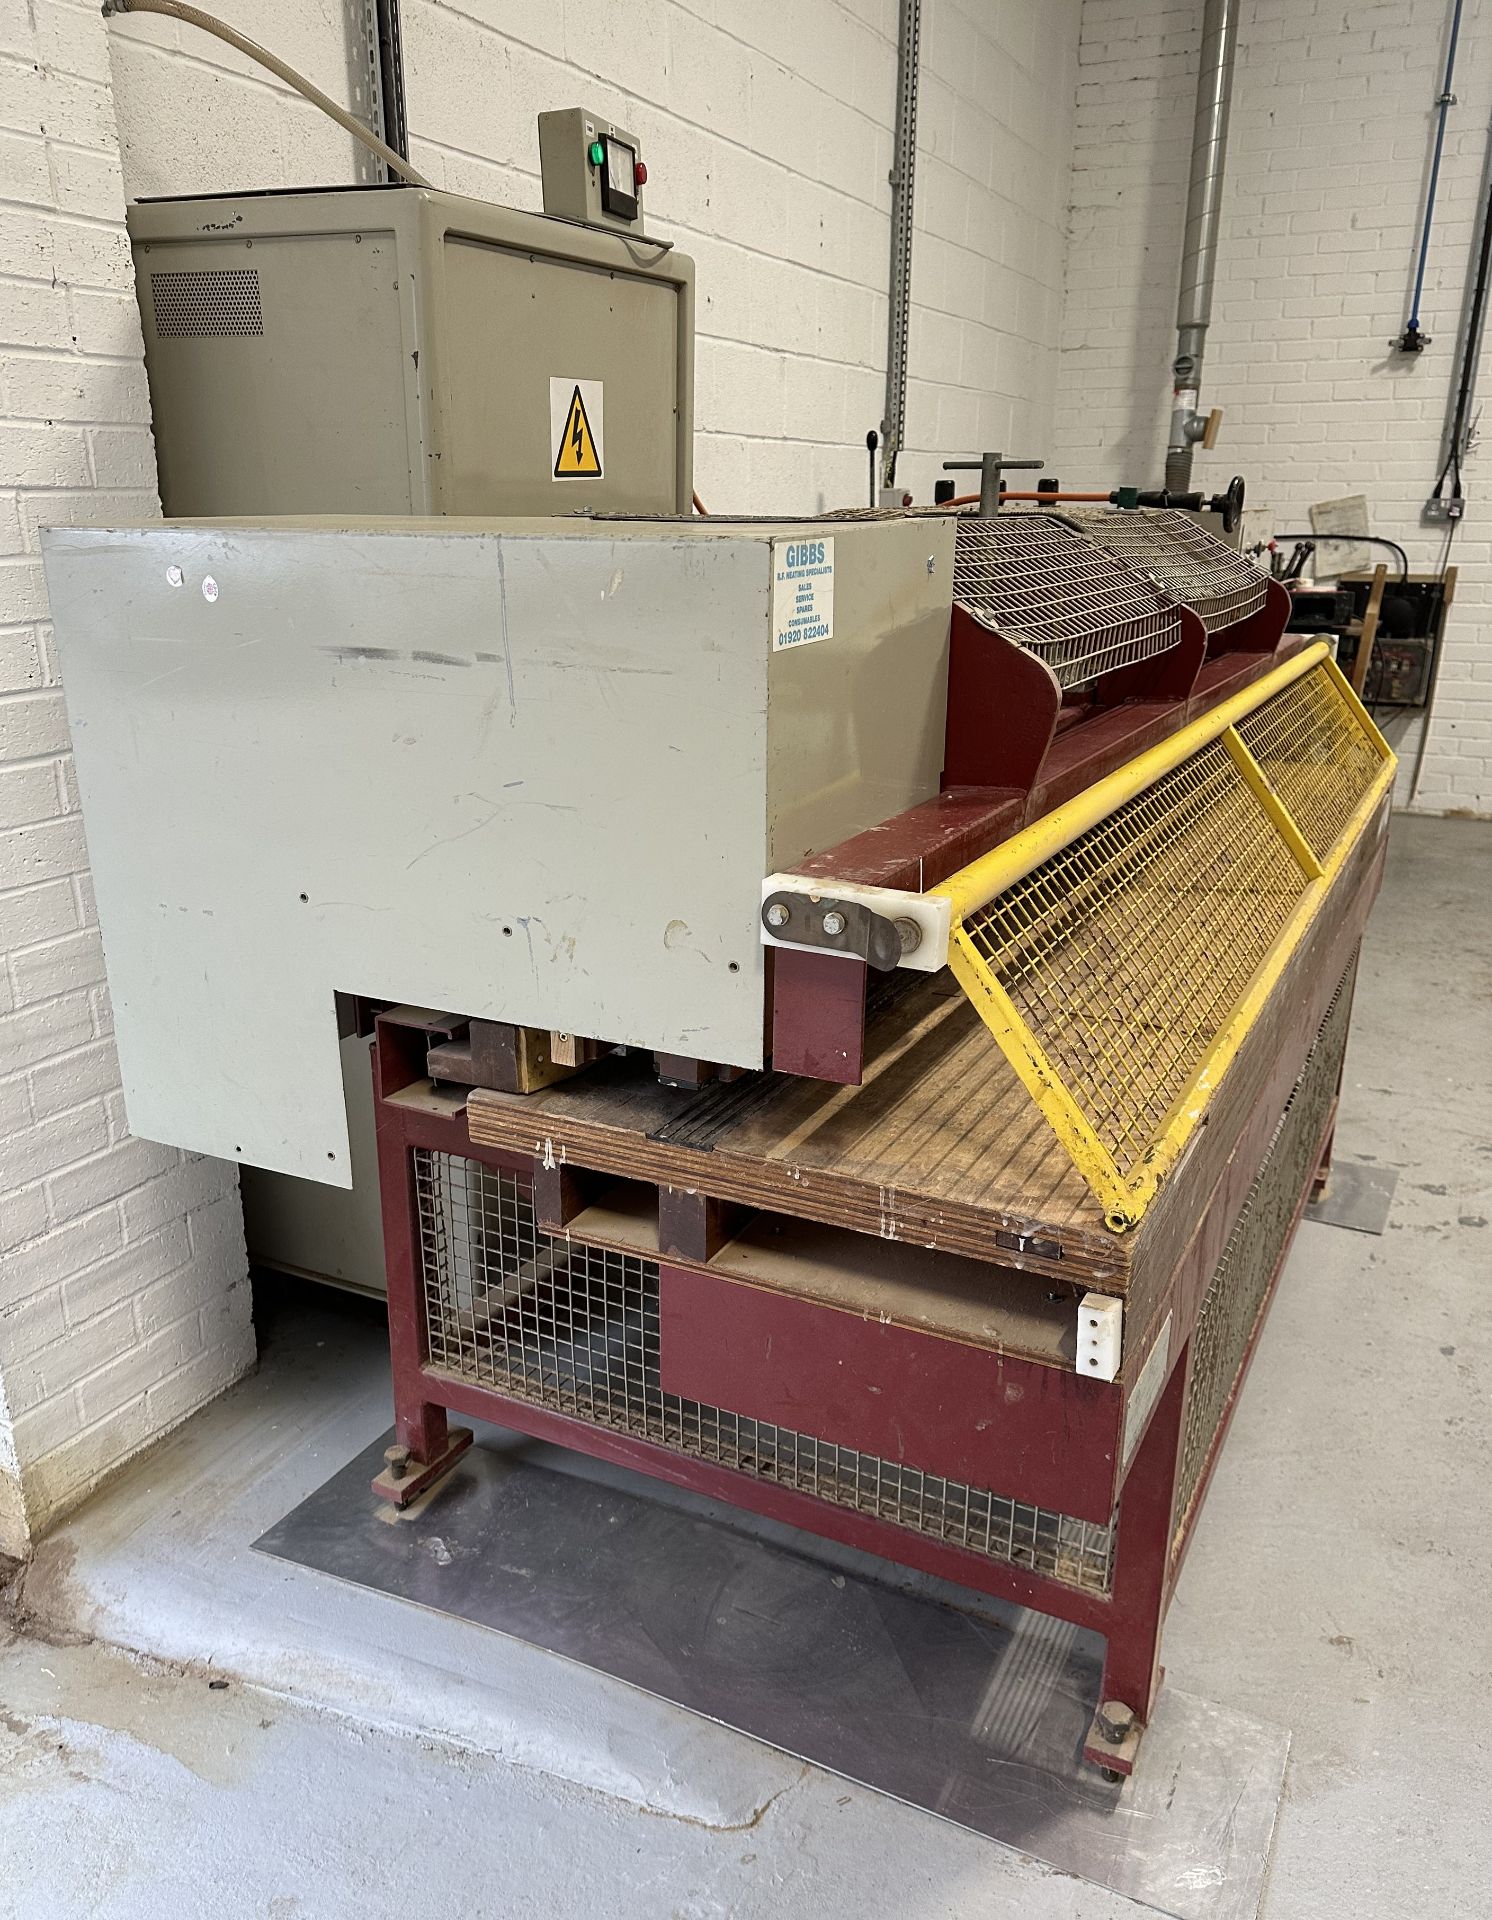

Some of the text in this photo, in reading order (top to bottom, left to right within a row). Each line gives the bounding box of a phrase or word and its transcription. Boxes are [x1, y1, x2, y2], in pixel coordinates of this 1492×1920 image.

[786, 542, 825, 568] GIBBS
[786, 570, 805, 580] HEATING
[806, 566, 832, 577] SPECIALISTS
[798, 583, 812, 592] SALES
[796, 593, 814, 603] SERVICE
[796, 604, 813, 614] SPARES
[788, 614, 821, 627] CONSUMABLES
[778, 624, 829, 646] 01920 822404
